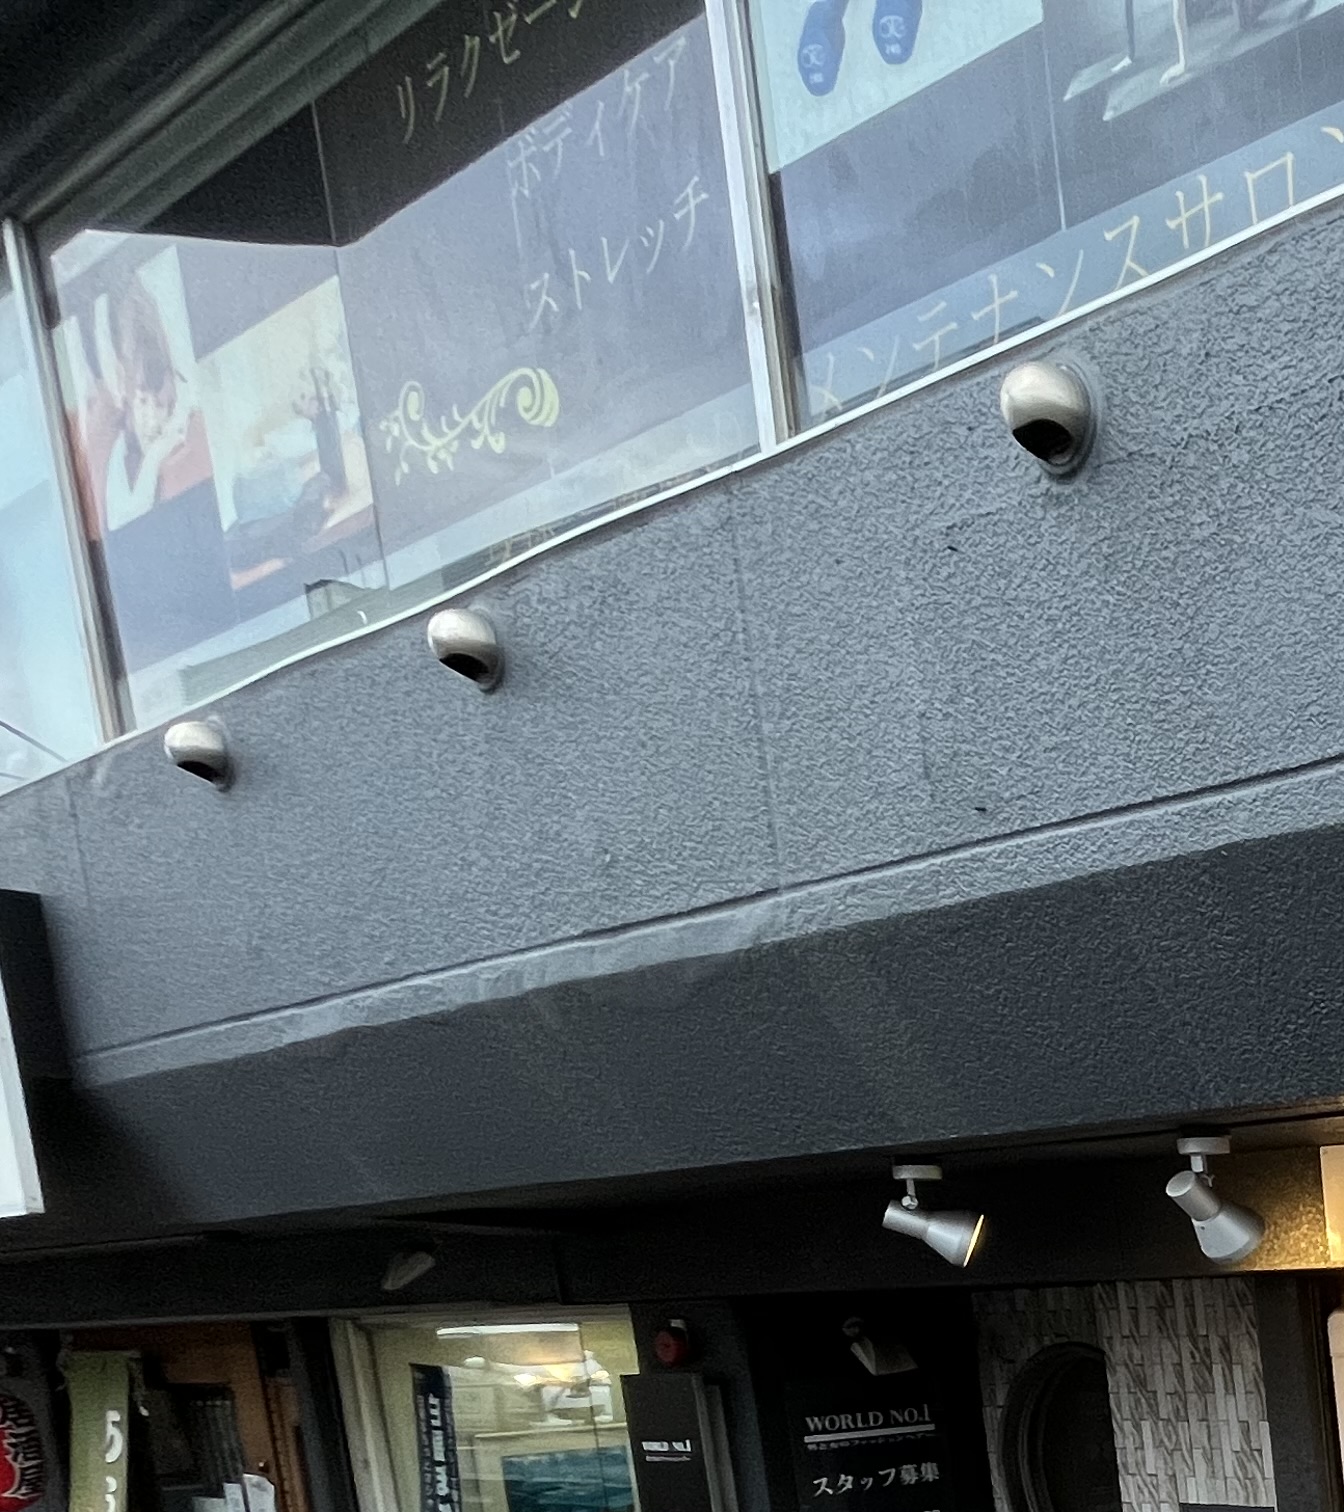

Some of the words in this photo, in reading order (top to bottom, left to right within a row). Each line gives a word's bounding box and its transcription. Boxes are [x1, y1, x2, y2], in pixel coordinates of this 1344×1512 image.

[397, 0, 585, 145] リラクゼー
[508, 37, 688, 196] ボディケア
[528, 176, 709, 332] ストレッチ
[805, 1410, 884, 1433] WORLD
[889, 1403, 932, 1425] NO.1
[812, 1461, 940, 1498] スタッフ募集
